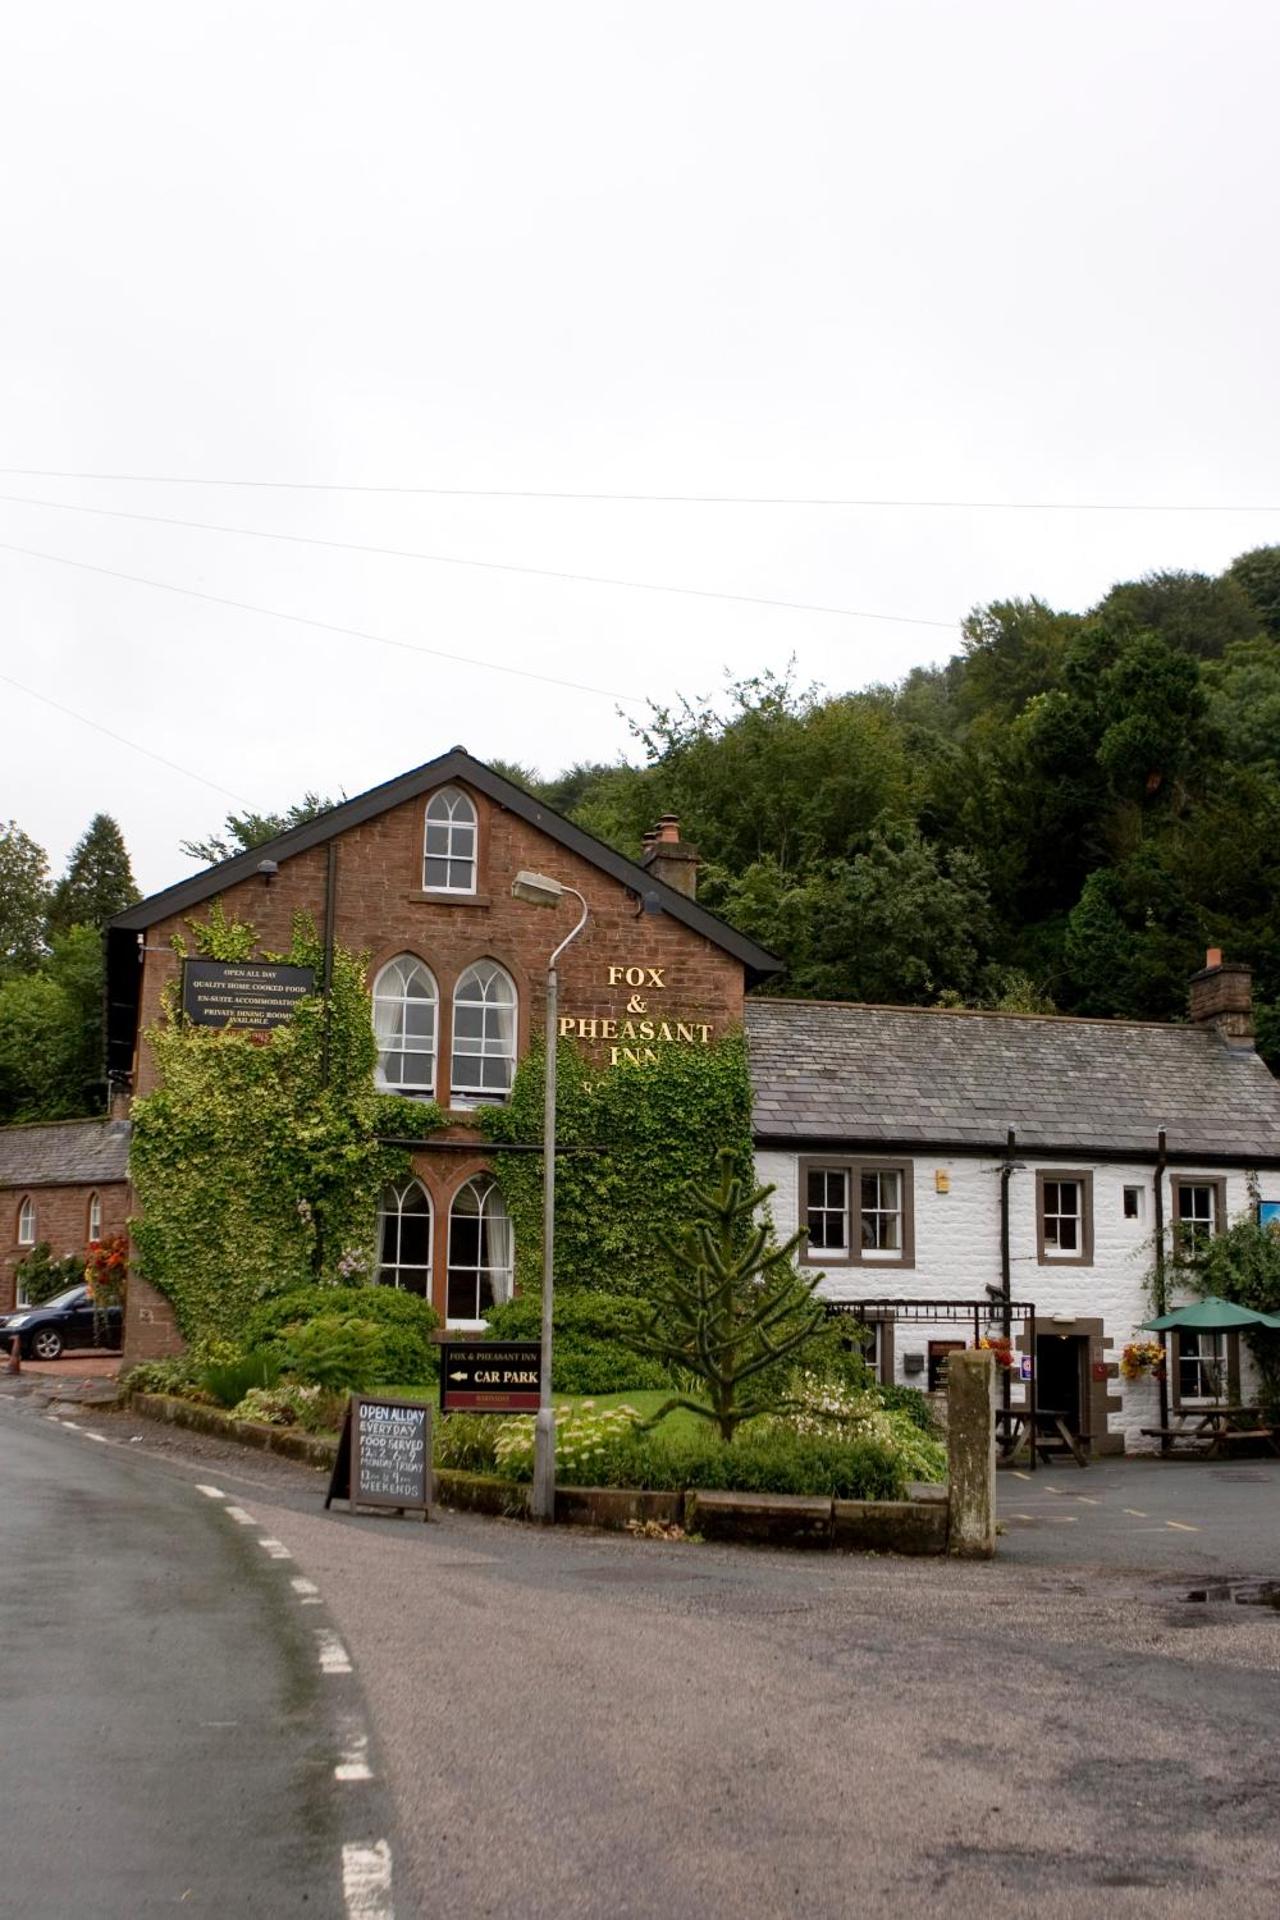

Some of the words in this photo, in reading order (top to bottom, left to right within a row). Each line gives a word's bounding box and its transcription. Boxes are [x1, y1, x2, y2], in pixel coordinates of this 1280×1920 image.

[246, 970, 261, 978] ALL
[608, 966, 666, 988] FOX
[193, 981, 225, 989] QUALITY
[285, 985, 306, 993] FOOD
[198, 995, 233, 1003] EN-SUITE
[626, 994, 648, 1014] &
[558, 1017, 714, 1043] PHEASANT
[610, 1046, 661, 1068] INN
[476, 1353, 519, 1361] PHEASANT
[521, 1353, 538, 1361] INN
[474, 1371, 501, 1383] CAR
[502, 1371, 539, 1384] PARK
[360, 1405, 389, 1419] OPEN
[391, 1408, 406, 1421] ALL
[406, 1410, 425, 1425] DAY
[360, 1436, 386, 1447] FOOD
[388, 1440, 424, 1451] SERVED
[360, 1482, 418, 1496] WEEKENDS
